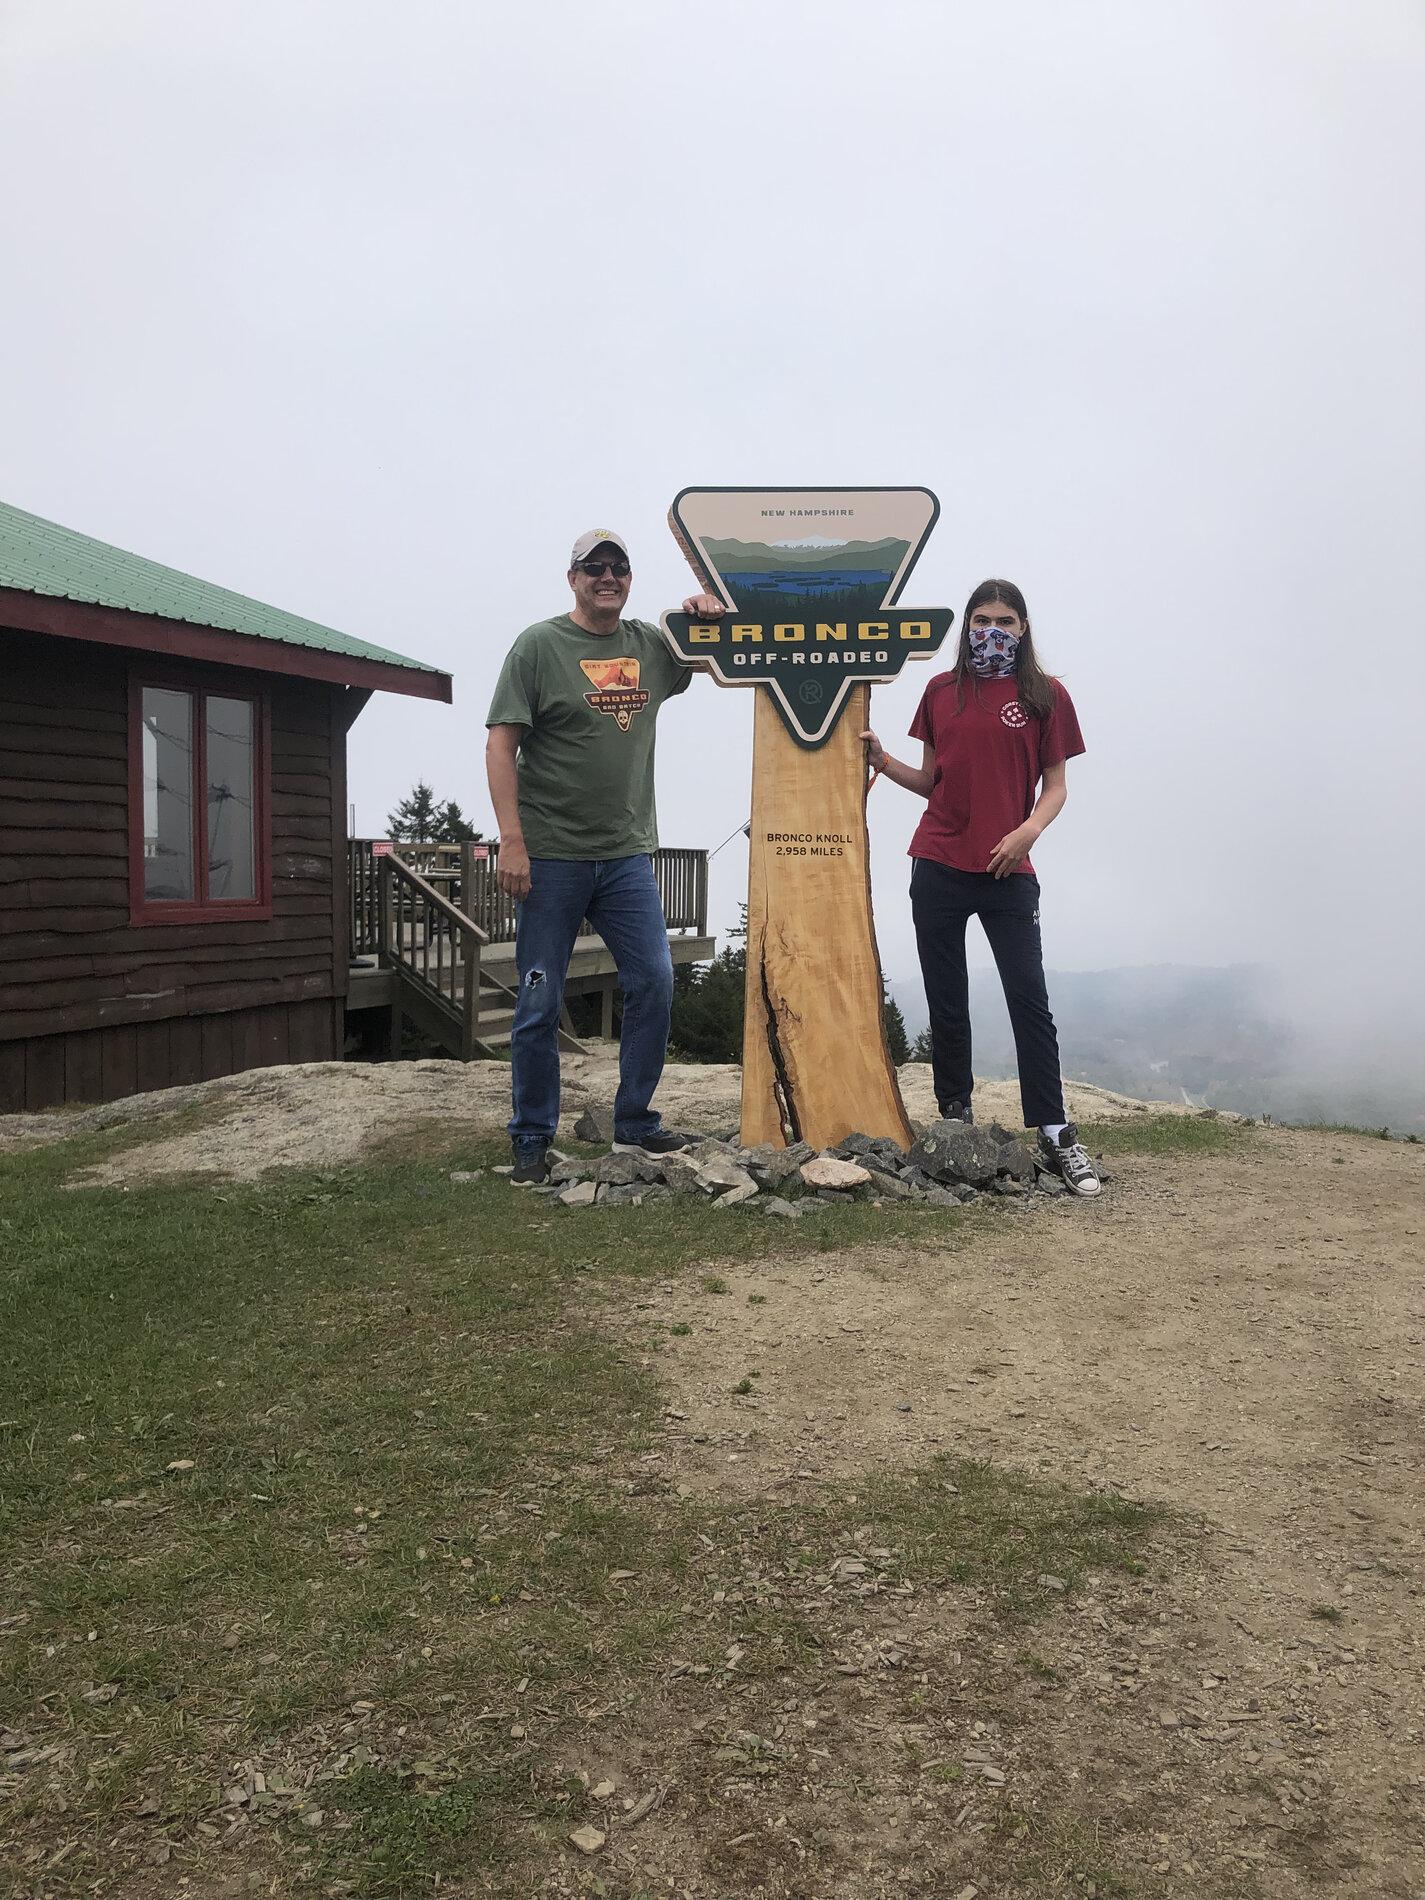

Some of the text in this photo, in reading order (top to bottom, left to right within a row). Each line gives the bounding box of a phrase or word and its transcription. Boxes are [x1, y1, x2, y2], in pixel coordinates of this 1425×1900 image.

[688, 621, 931, 643] BRONCO
[733, 650, 889, 665] OFF-ROADEO
[591, 693, 647, 703] BRONCO
[767, 833, 852, 843] BRONCO KNOLL
[776, 847, 843, 856] 2,958 MILES
